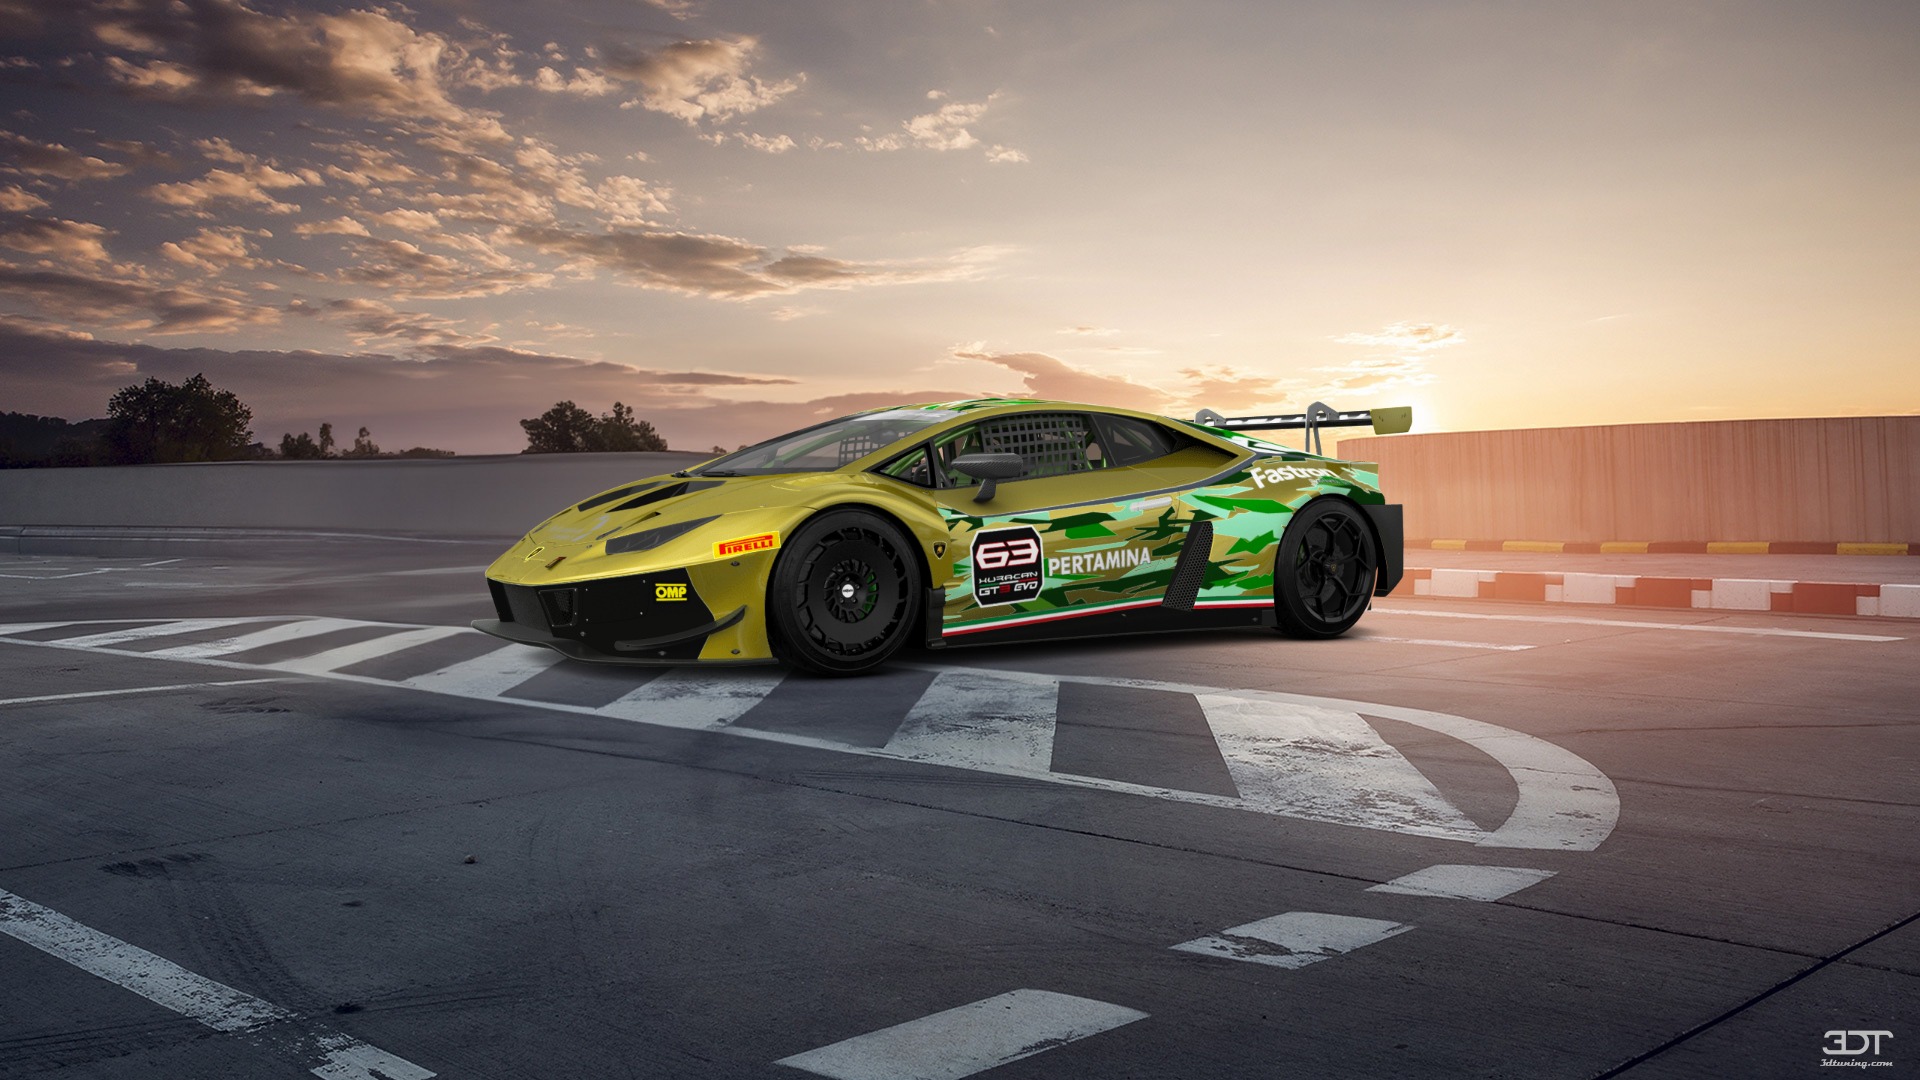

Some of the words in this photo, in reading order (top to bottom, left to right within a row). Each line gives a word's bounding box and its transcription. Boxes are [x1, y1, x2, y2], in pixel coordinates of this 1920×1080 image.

[1250, 465, 1340, 489] Fastron
[719, 534, 773, 555] PIRELLI
[976, 538, 1039, 570] 63
[1049, 547, 1151, 577] PERTAMINA
[655, 586, 687, 599] OMP
[979, 585, 1011, 597] GT3
[1013, 581, 1038, 592] EVO
